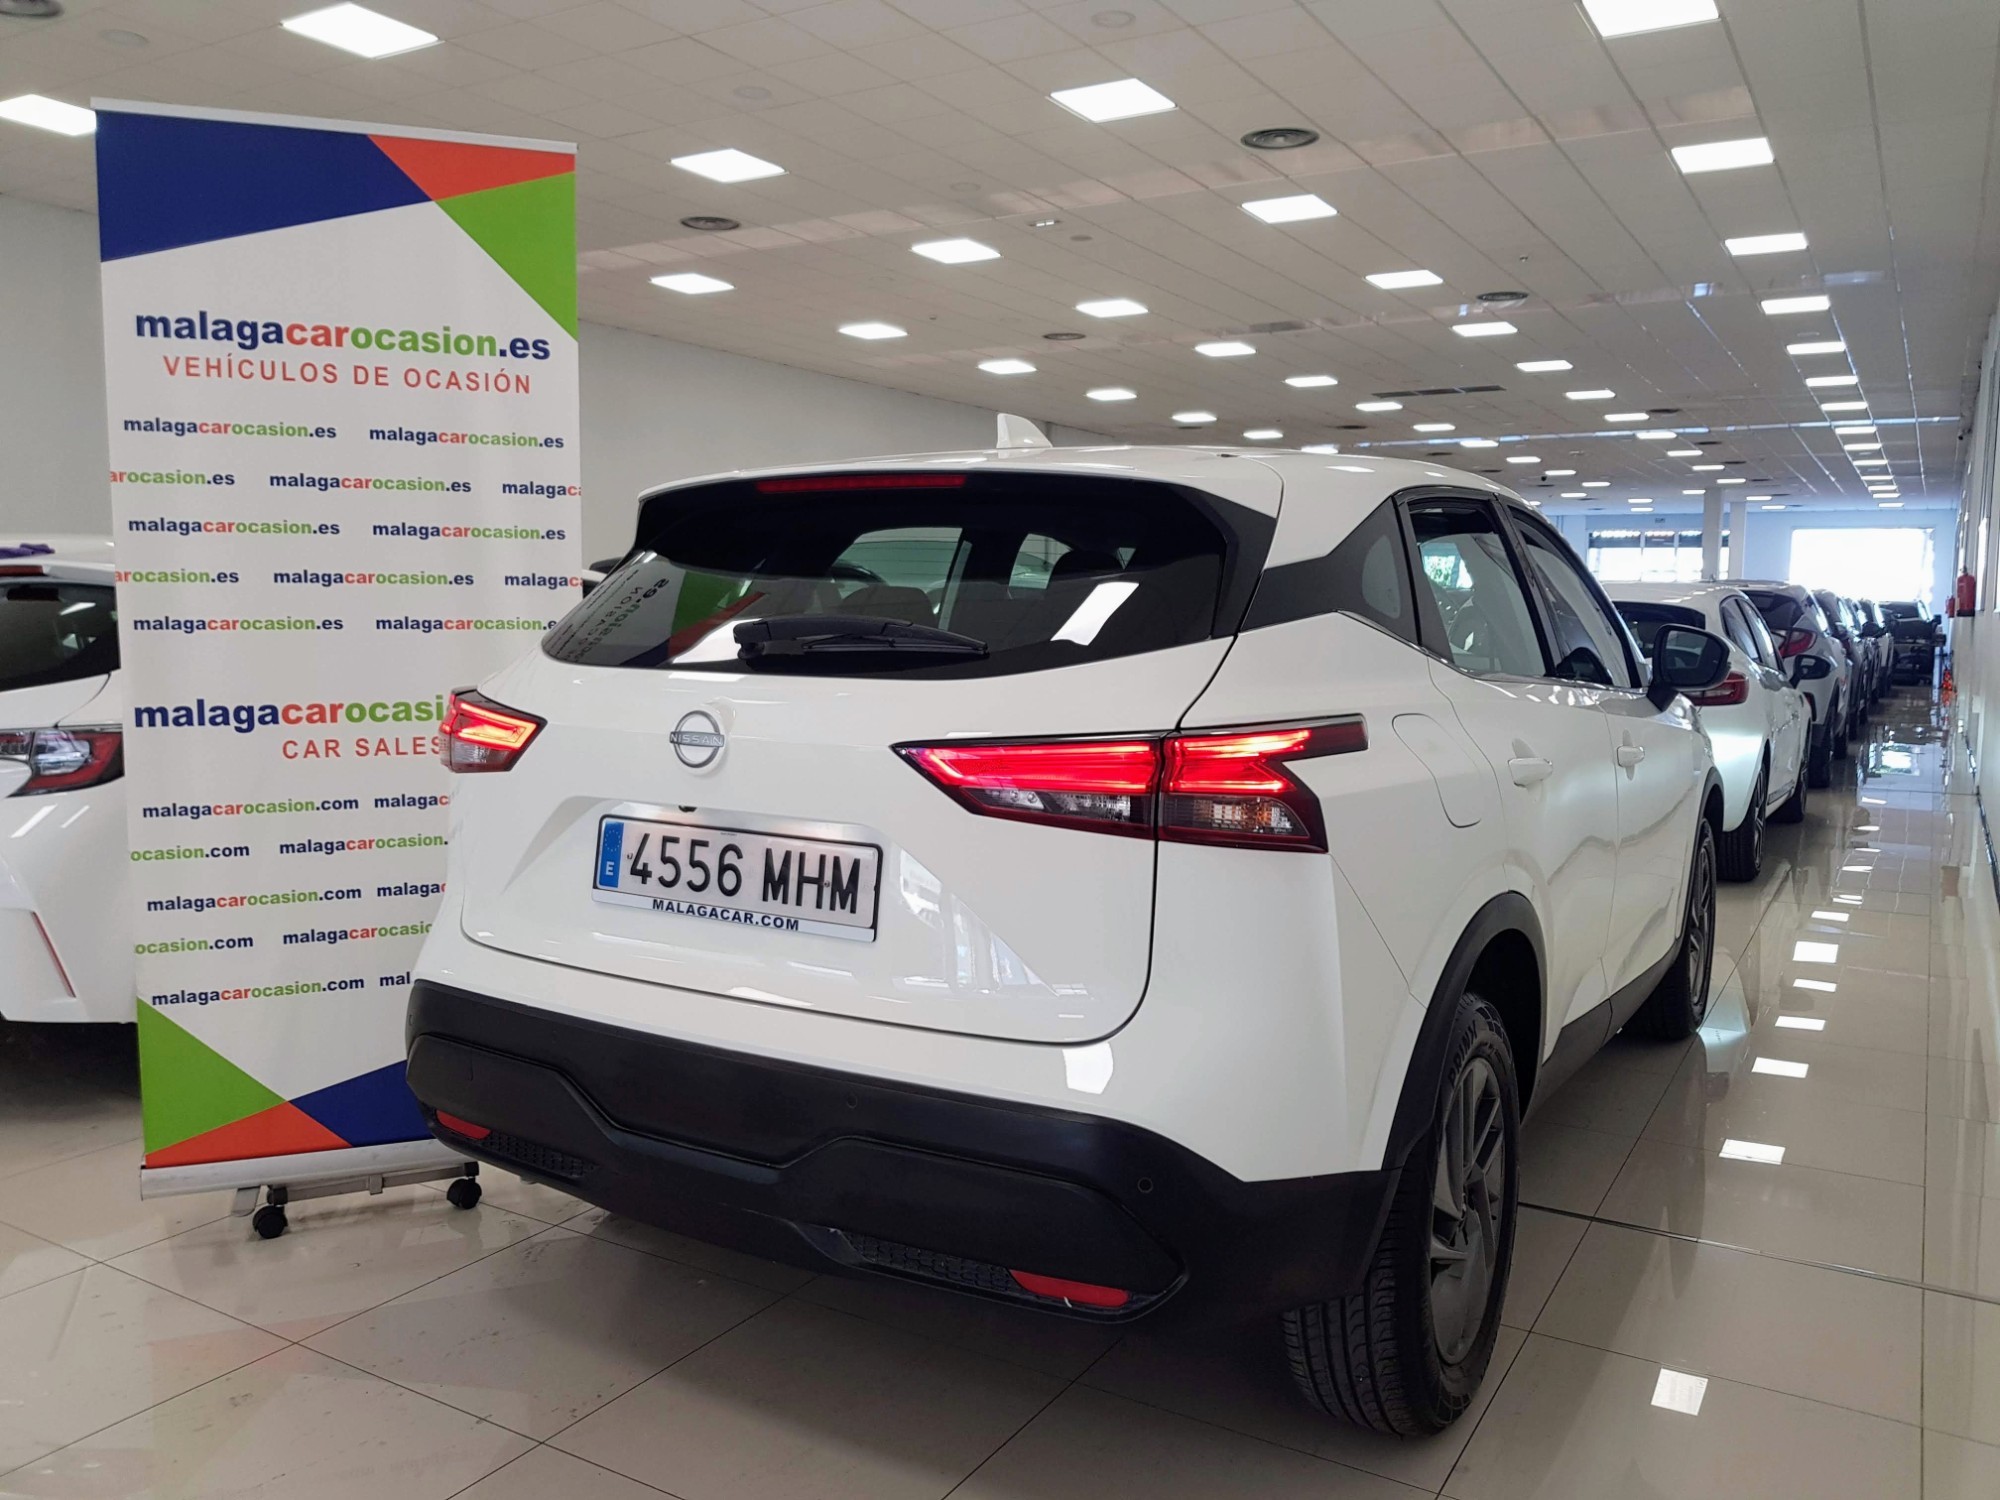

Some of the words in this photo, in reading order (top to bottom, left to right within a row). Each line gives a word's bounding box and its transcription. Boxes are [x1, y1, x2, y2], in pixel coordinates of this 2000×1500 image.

[136, 311, 551, 360] malagacarocasion.es
[163, 353, 338, 384] VEHÍCULOS
[353, 365, 389, 387] DE
[403, 367, 531, 394] OCASIÓN
[123, 417, 337, 439] malagacarocasion.es
[369, 427, 565, 449] malagacarocasion.es
[269, 473, 472, 494] malagacarocasion.es
[502, 480, 582, 499] malagac
[128, 517, 341, 537] malagacarocasion.es
[372, 522, 566, 541] malagacarocasion.es
[273, 569, 475, 588] malagacarocasion.es
[504, 572, 583, 590] malagac
[133, 616, 344, 635] malagacarocasion.es
[135, 695, 445, 733] malagacarocasi
[283, 738, 342, 760] CAR
[354, 735, 440, 758] SALES
[670, 731, 724, 747] NISSAN
[142, 797, 360, 821] malagacarocasion.com
[130, 843, 250, 862] ocasion.com
[605, 861, 614, 876] E
[629, 832, 743, 898] 4556
[762, 847, 861, 915] MHM
[146, 887, 362, 912] malagacarocasion.com
[652, 898, 800, 932] MALAGACAR.COM
[134, 935, 254, 955] ocasion.com
[151, 978, 364, 1006] malagacarocasion.com
